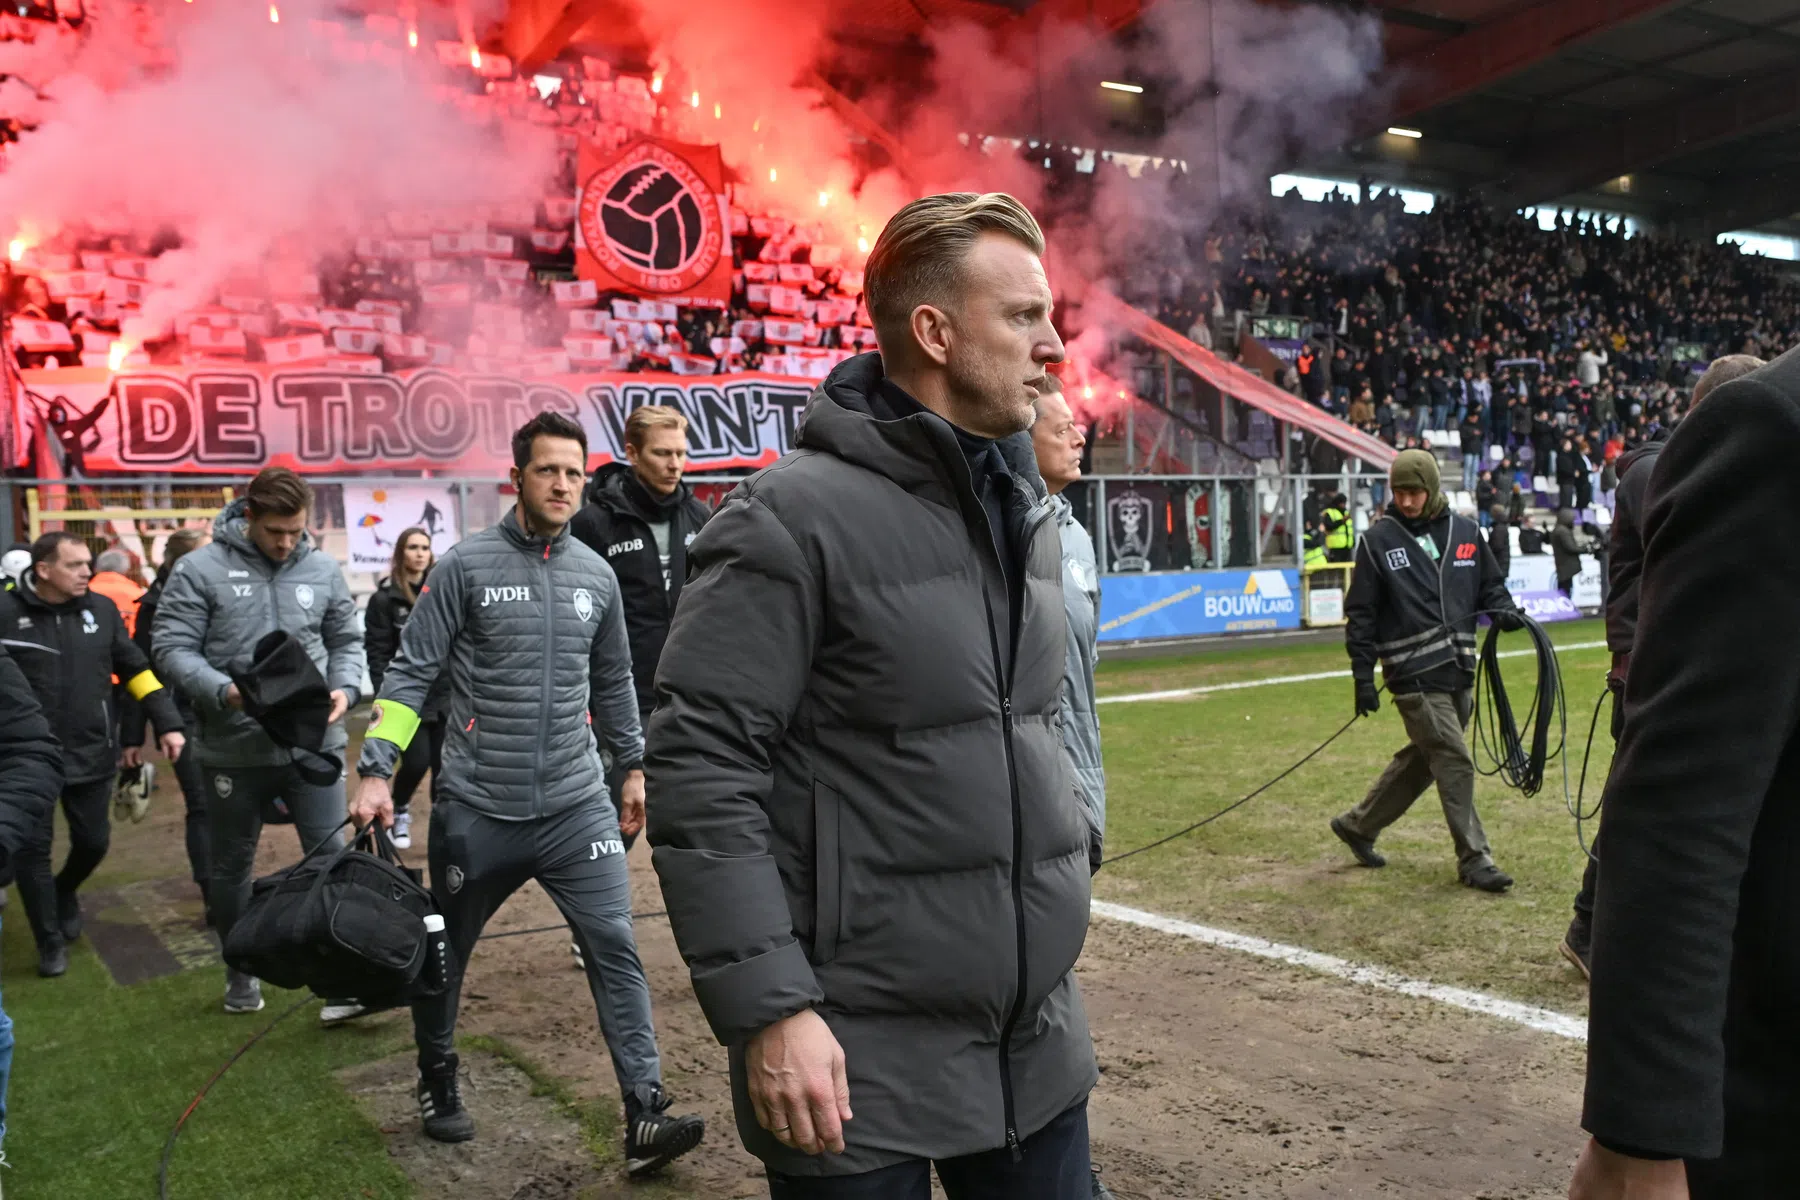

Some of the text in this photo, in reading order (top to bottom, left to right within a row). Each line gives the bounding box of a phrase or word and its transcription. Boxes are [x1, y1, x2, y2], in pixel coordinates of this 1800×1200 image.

[114, 373, 266, 466] DE
[586, 383, 814, 462] VAN'T
[607, 538, 644, 557] BVDB
[231, 584, 253, 597] YZ
[480, 586, 531, 607] JVDH
[1204, 594, 1295, 618] BOUWLAND
